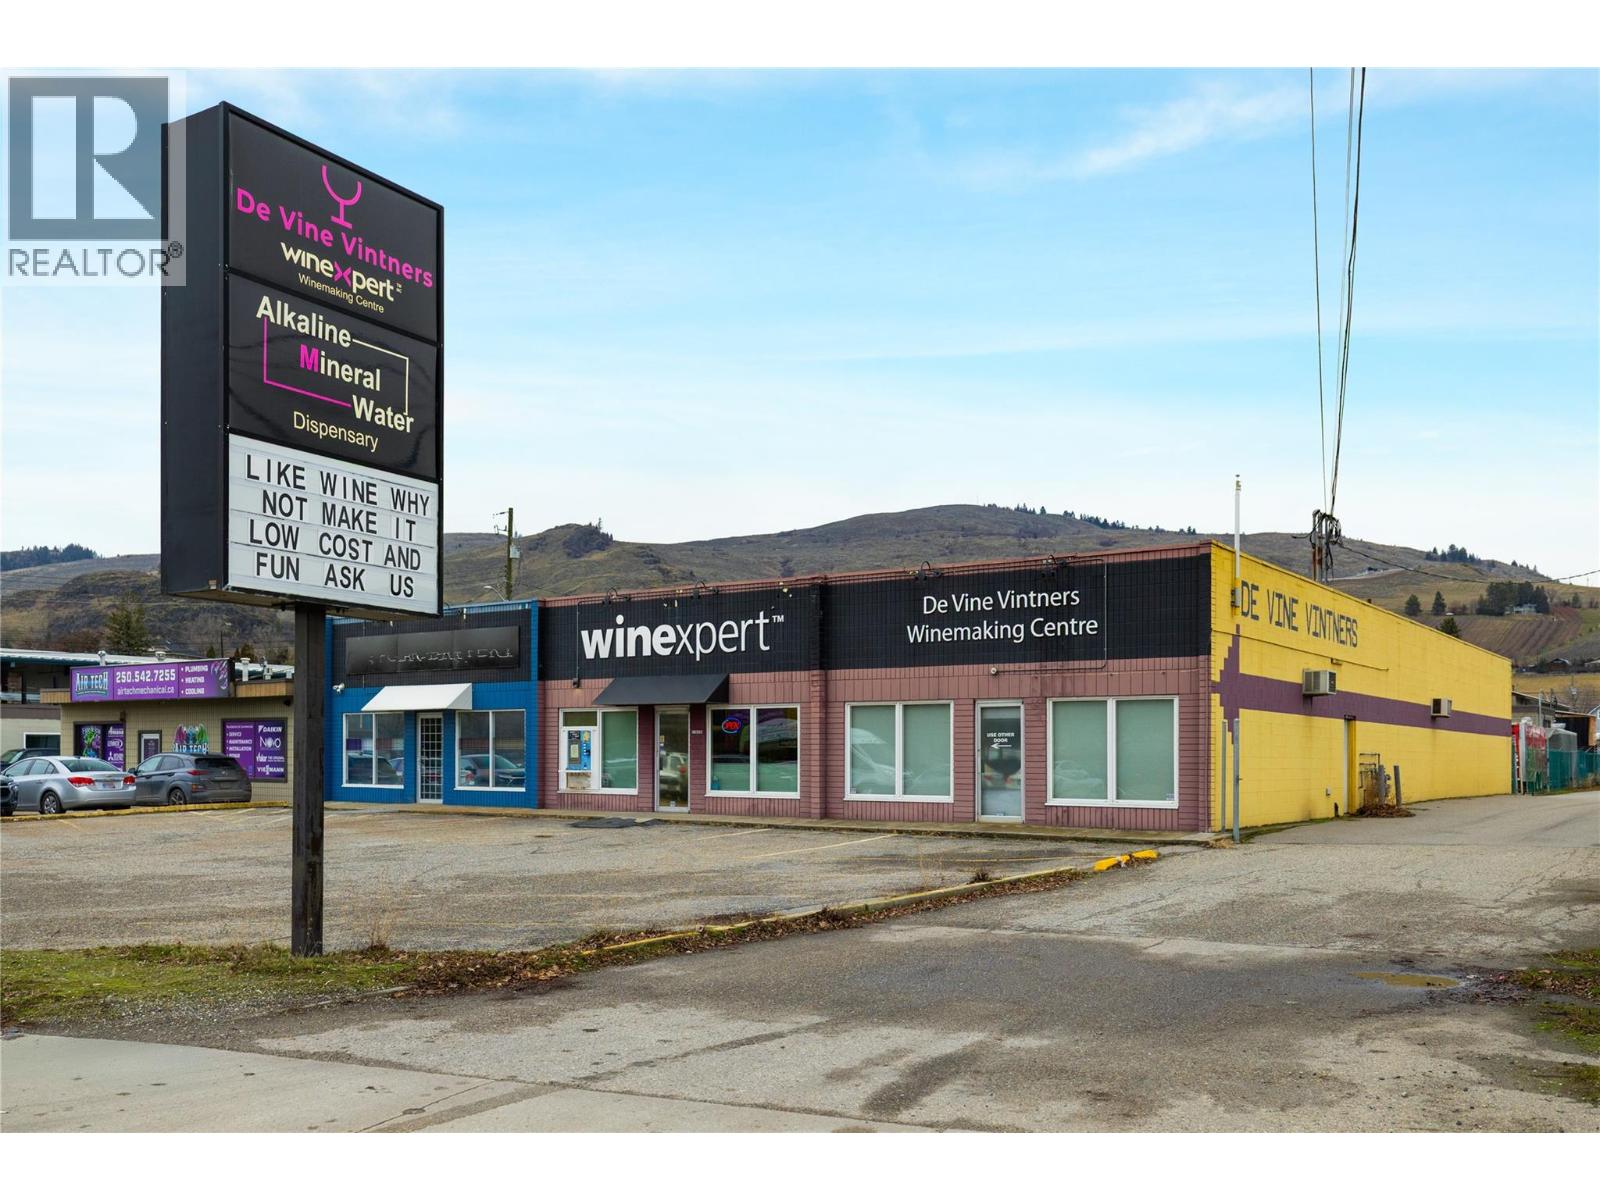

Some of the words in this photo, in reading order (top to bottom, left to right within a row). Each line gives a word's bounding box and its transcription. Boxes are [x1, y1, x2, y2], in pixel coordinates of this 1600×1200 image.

[236, 187, 271, 222] De
[279, 205, 334, 247] Vine
[341, 231, 433, 288] Vintners
[299, 273, 354, 304] Winemaking
[356, 294, 385, 314] Centre
[256, 295, 351, 348] Alkaline
[300, 343, 381, 392] Mineral
[293, 411, 379, 453] Dispensary
[352, 395, 414, 433] Water
[246, 454, 306, 490] LIKE
[320, 470, 377, 506] WINE
[390, 487, 430, 516] WHY
[262, 489, 308, 521] NOT
[322, 501, 377, 534] MAKE
[395, 517, 416, 541] IT
[249, 518, 299, 550] LOW
[319, 532, 373, 563] COST
[384, 544, 421, 571] AND
[256, 551, 299, 581] FUN
[324, 563, 365, 591] ASK
[390, 573, 414, 598] US
[923, 595, 948, 615] De
[952, 593, 993, 612] Vine
[997, 589, 1080, 609] Vintners
[1241, 580, 1259, 621] DE
[1267, 588, 1298, 632] VINE
[1305, 602, 1358, 648] VINTNERS
[907, 620, 1025, 644] Winemaking
[1030, 617, 1099, 637] Centre
[75, 672, 88, 691] AIR
[89, 671, 109, 690] TECH
[116, 669, 176, 683] 250.542.7255
[117, 685, 175, 696] airtechmechanical.ca
